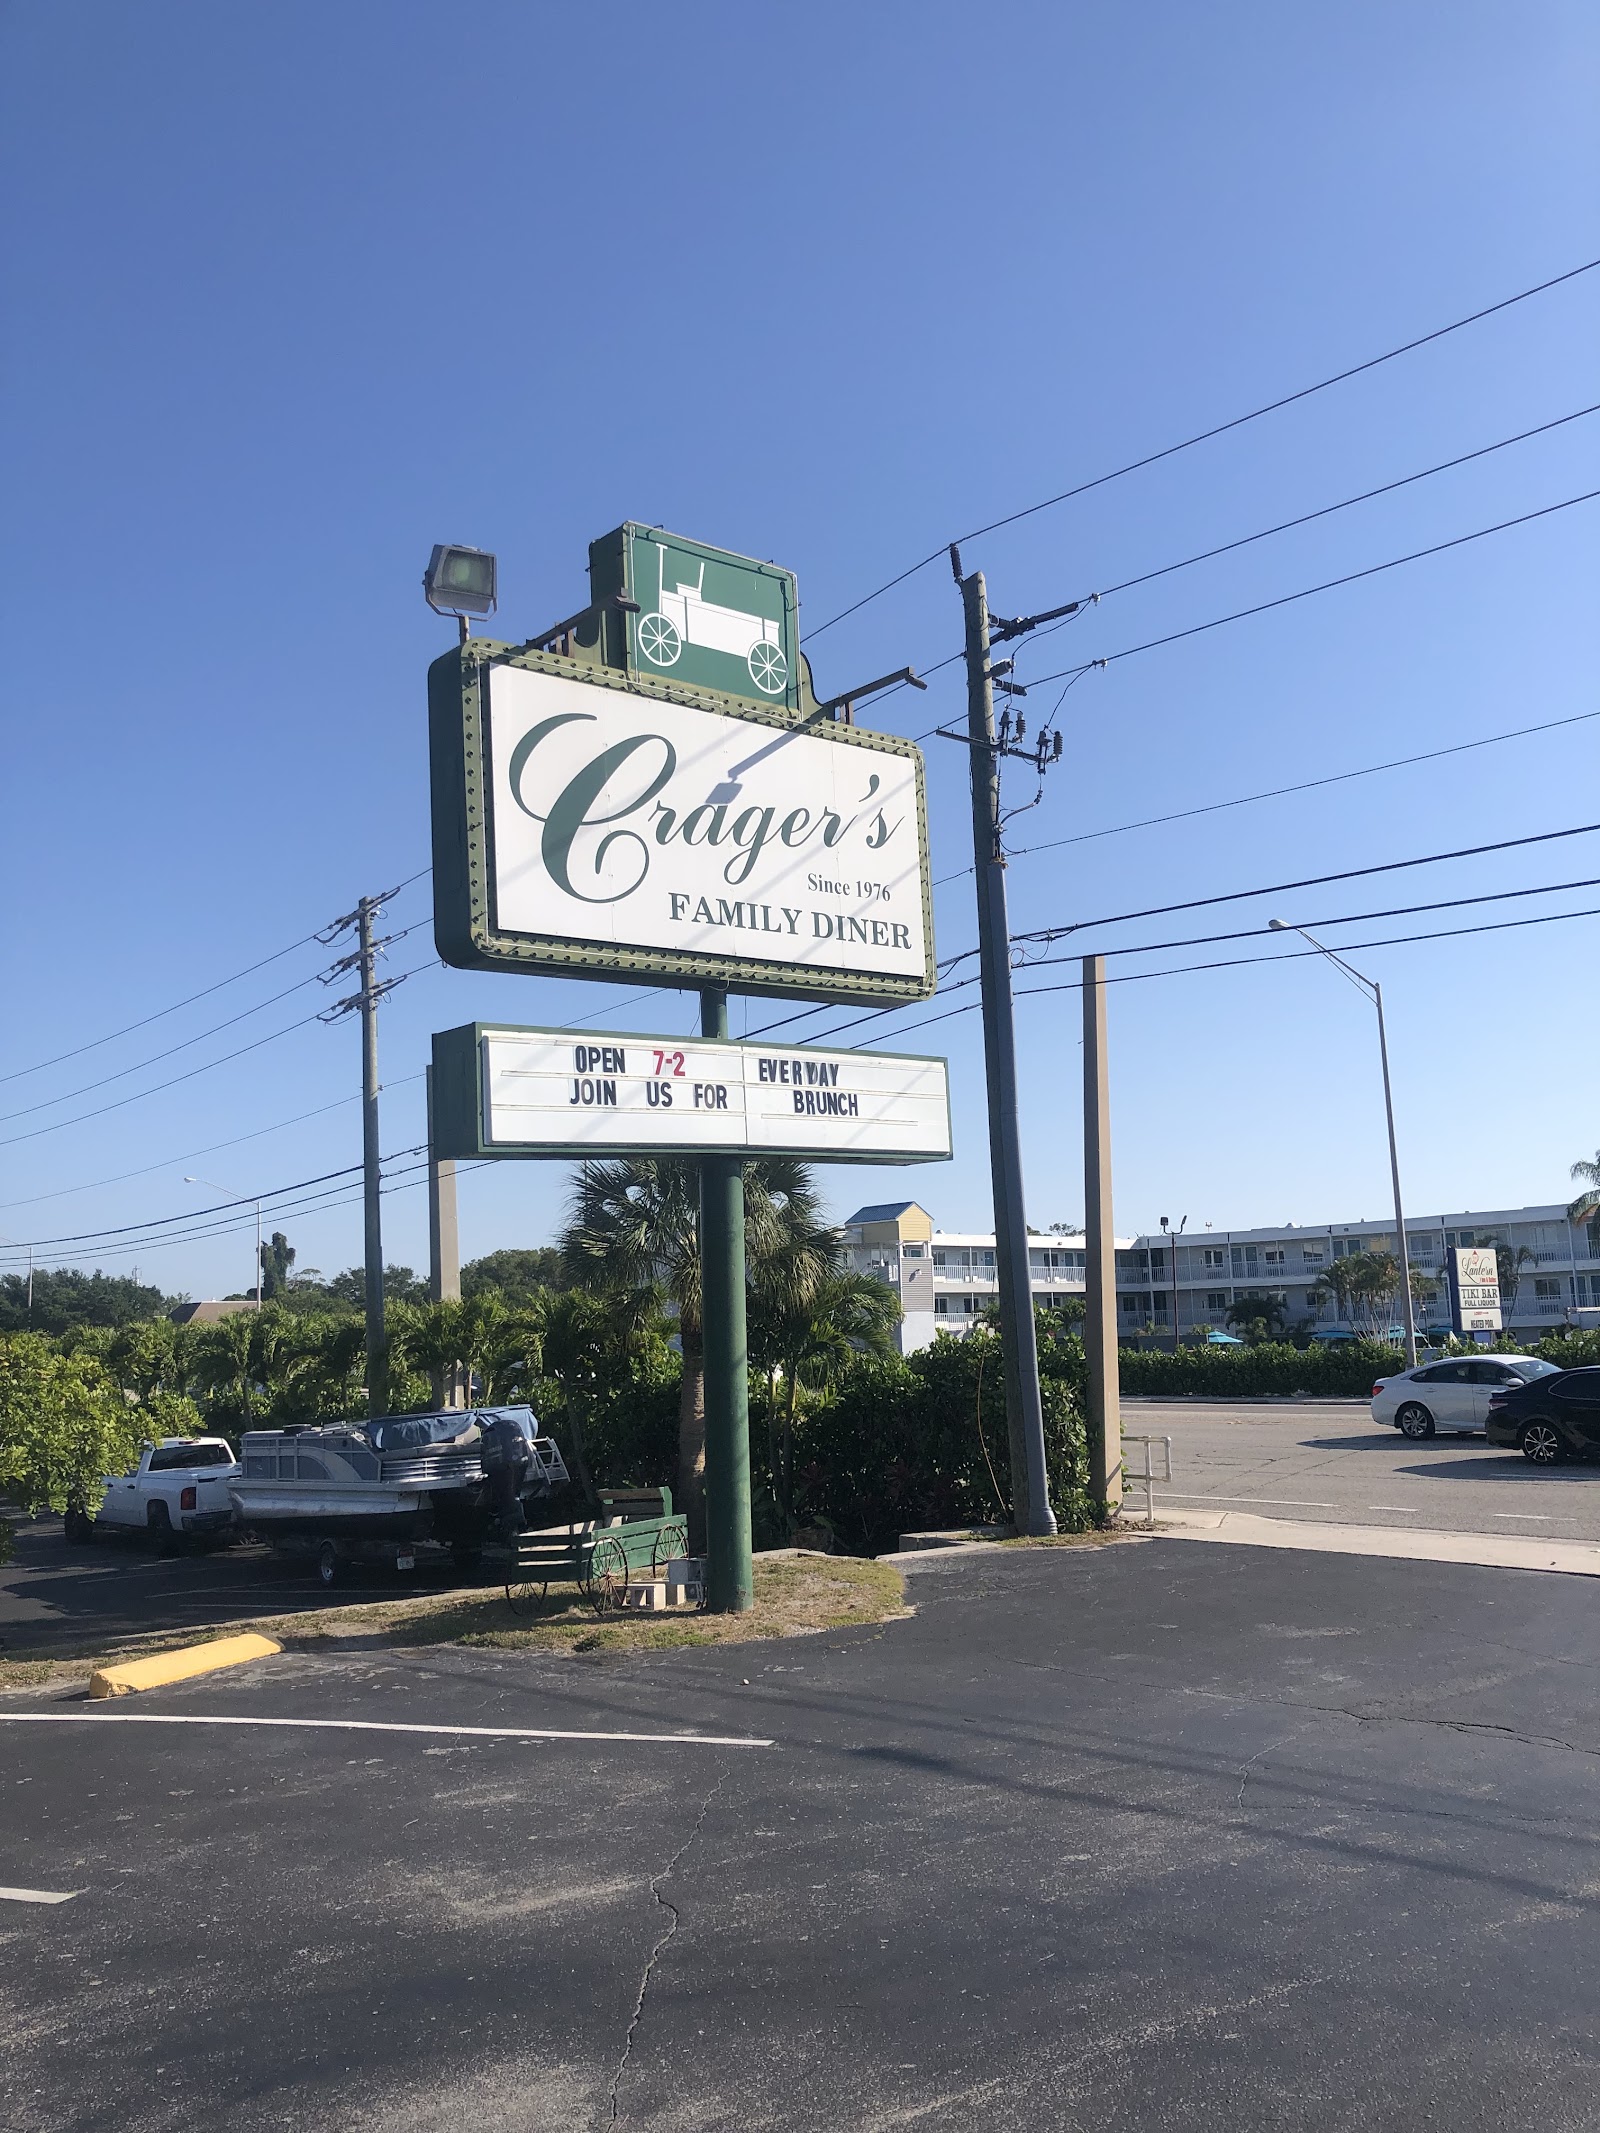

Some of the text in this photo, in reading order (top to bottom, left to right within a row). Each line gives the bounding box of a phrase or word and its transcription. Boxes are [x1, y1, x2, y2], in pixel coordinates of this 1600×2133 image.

[508, 713, 904, 903] Crager's
[807, 872, 891, 901] Since 1976
[668, 892, 912, 949] FAMILY DINER
[575, 1045, 625, 1073] OPEN
[653, 1050, 686, 1076] 7-2
[569, 1078, 859, 1116] JOIN US FOR BRUNCH
[1461, 1289, 1498, 1299] TIKI BAR
